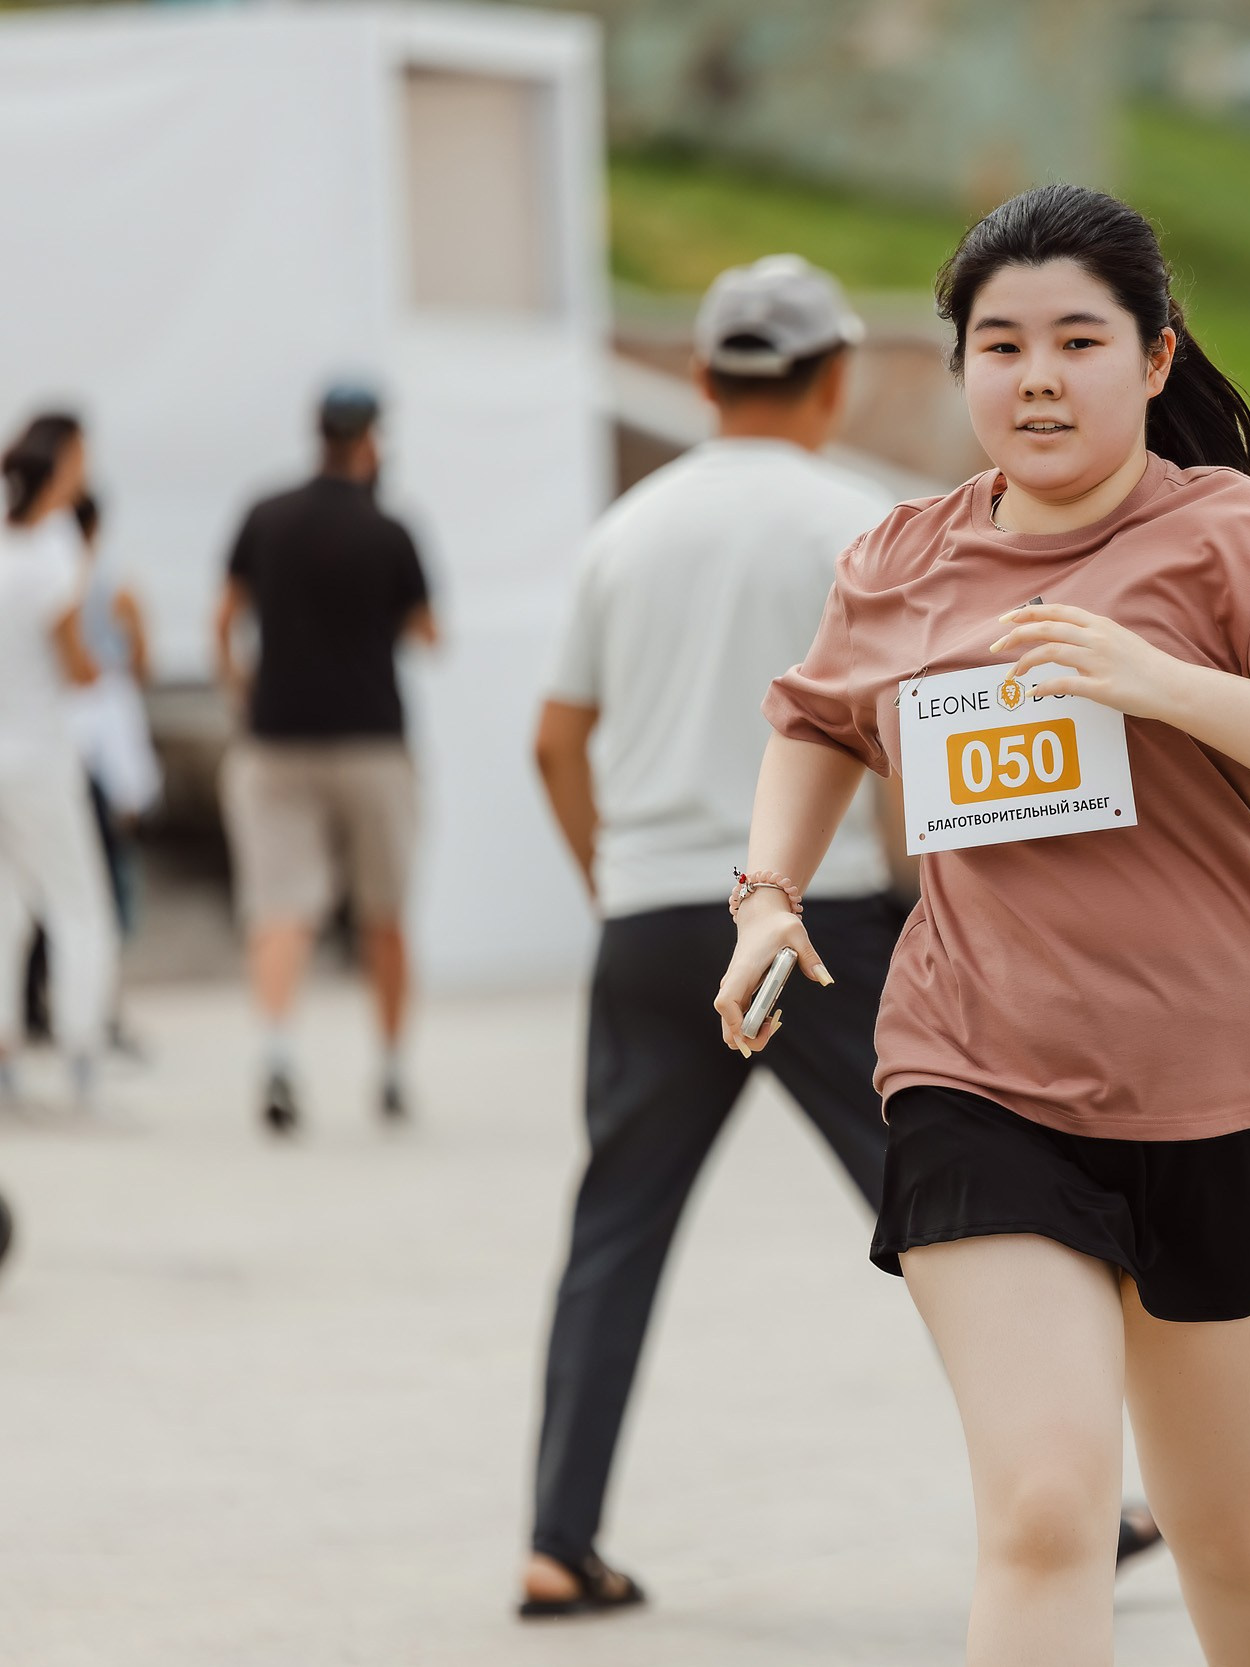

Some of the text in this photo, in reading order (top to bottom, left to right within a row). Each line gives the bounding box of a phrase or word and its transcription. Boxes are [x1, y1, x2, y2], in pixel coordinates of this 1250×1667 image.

[918, 690, 990, 720] LEONE
[961, 730, 1064, 793] 050
[927, 797, 1110, 832] БЛАГОТВОРИТЕЛЬНЫЙ ЗАБЕГ
